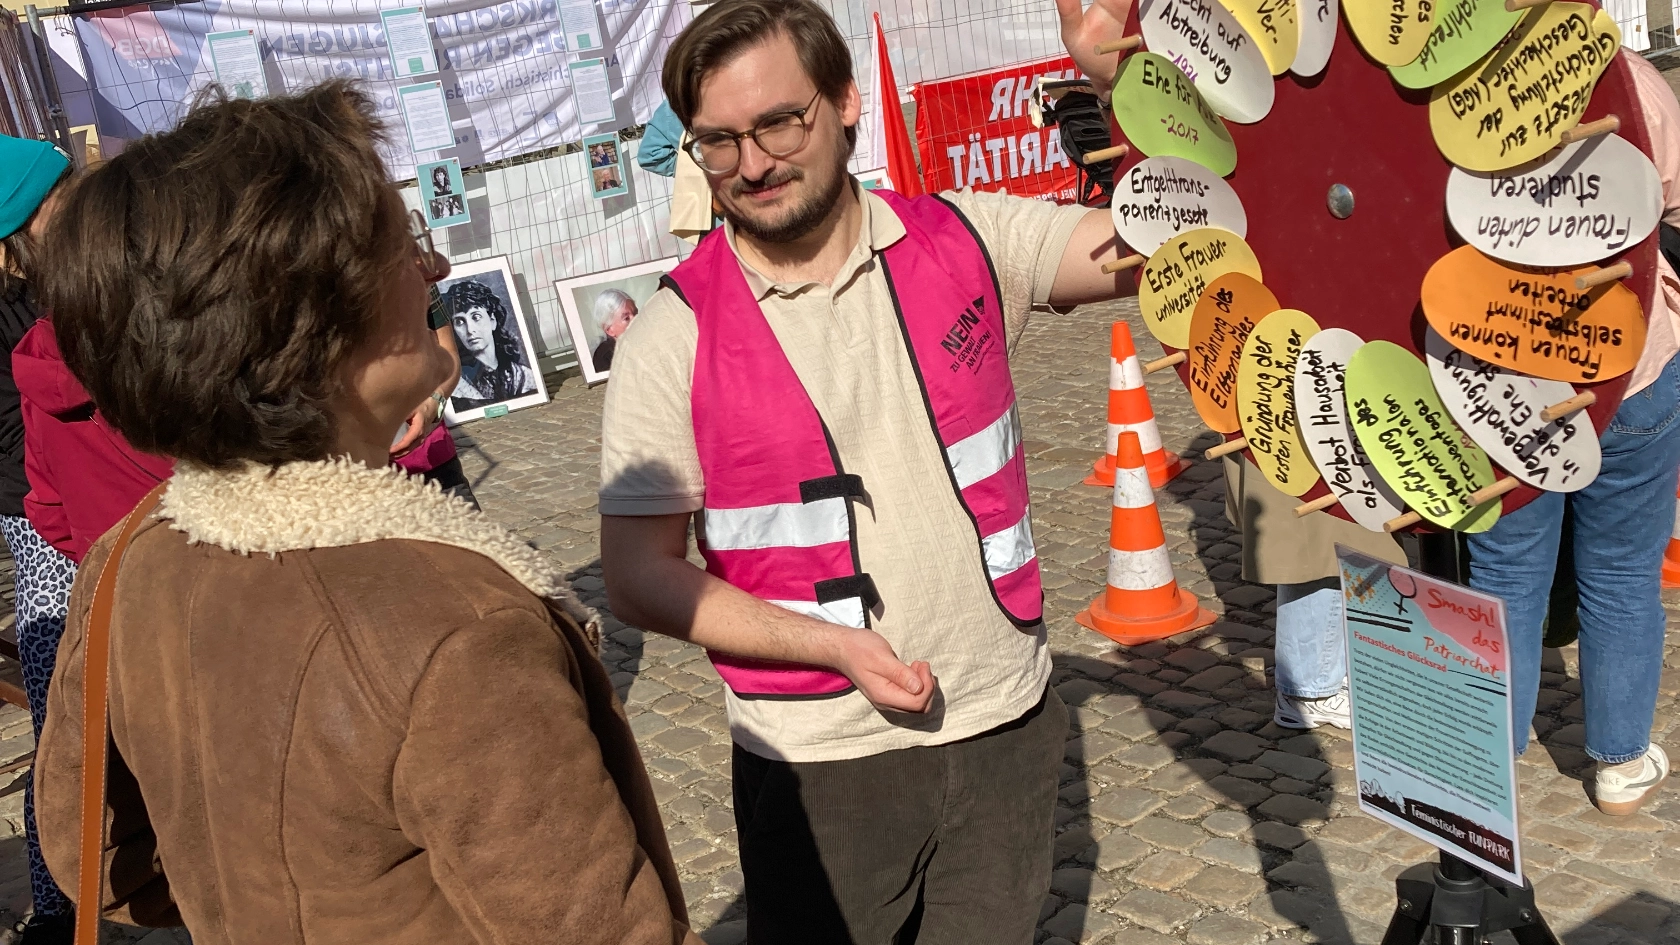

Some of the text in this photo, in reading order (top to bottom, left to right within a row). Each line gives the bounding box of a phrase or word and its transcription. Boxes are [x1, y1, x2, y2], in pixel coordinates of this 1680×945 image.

[1159, 1, 1232, 85] Abtreibung
[1217, 21, 1248, 53] auf
[1141, 59, 1171, 95] Ehe
[1174, 78, 1193, 105] für
[1508, 31, 1616, 112] Gleichstellung
[1160, 113, 1200, 145] -2017
[1476, 105, 1503, 139] der
[1498, 123, 1528, 157] zur
[1130, 166, 1210, 202] Entgelttrans-
[1490, 170, 1600, 208] studieren
[1477, 212, 1632, 250] Frauen dürfen
[1144, 239, 1228, 294] Erste Frauen-
[1155, 273, 1207, 323] universität
[1509, 278, 1591, 312] arbeiten
[940, 307, 981, 357] NEIN
[1485, 300, 1623, 347] selbstbestimmt
[949, 335, 977, 374] ZU GEWALT
[965, 355, 977, 370] AN
[972, 331, 992, 359] FRAUEN!
[1191, 314, 1234, 394] Einführung
[1449, 321, 1602, 380] Frauen können
[1246, 334, 1281, 455] Gründung der
[1443, 348, 1549, 485] Vergewaltigung
[1502, 381, 1532, 428] Ehe
[1301, 349, 1355, 499] Verbot Hausarbeit
[1413, 397, 1484, 494] Frauentages
[1532, 427, 1561, 458] der
[1274, 435, 1293, 485] ersten
[1353, 397, 1453, 519] Einführung des
[1561, 458, 1581, 484] in
[1355, 479, 1378, 509] als
[1426, 587, 1497, 631] Smash!
[1353, 630, 1407, 660] Fantastisches
[1406, 647, 1448, 674] Glücksrad
[1422, 635, 1501, 680] Patriarchat
[1471, 627, 1501, 655] das
[1409, 802, 1512, 864] Feministischer FUNPARK
